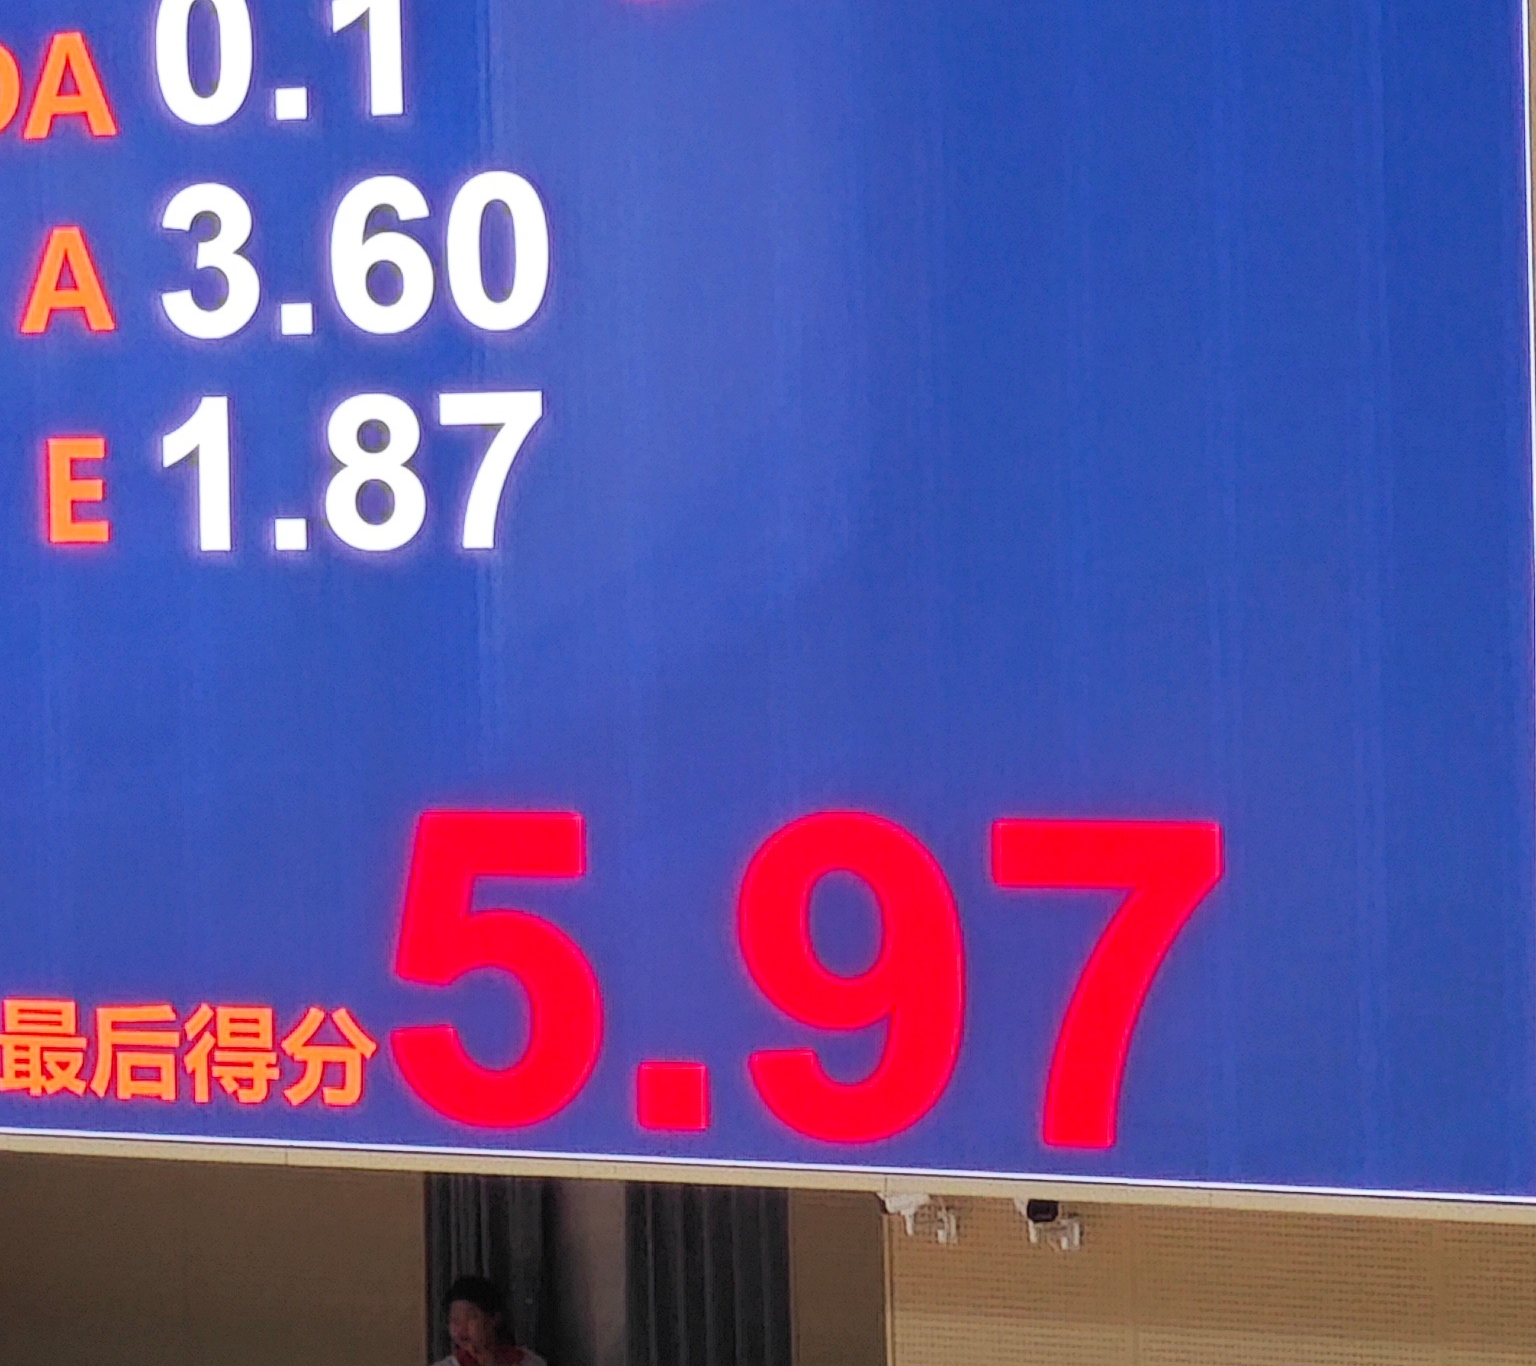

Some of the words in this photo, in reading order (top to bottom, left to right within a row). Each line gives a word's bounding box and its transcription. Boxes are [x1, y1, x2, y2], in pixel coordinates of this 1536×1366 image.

[21, 226, 115, 334] A
[162, 171, 548, 338] 3.60
[46, 436, 110, 544] E
[163, 392, 542, 550] 1.87
[391, 810, 1222, 1148] 5.97
